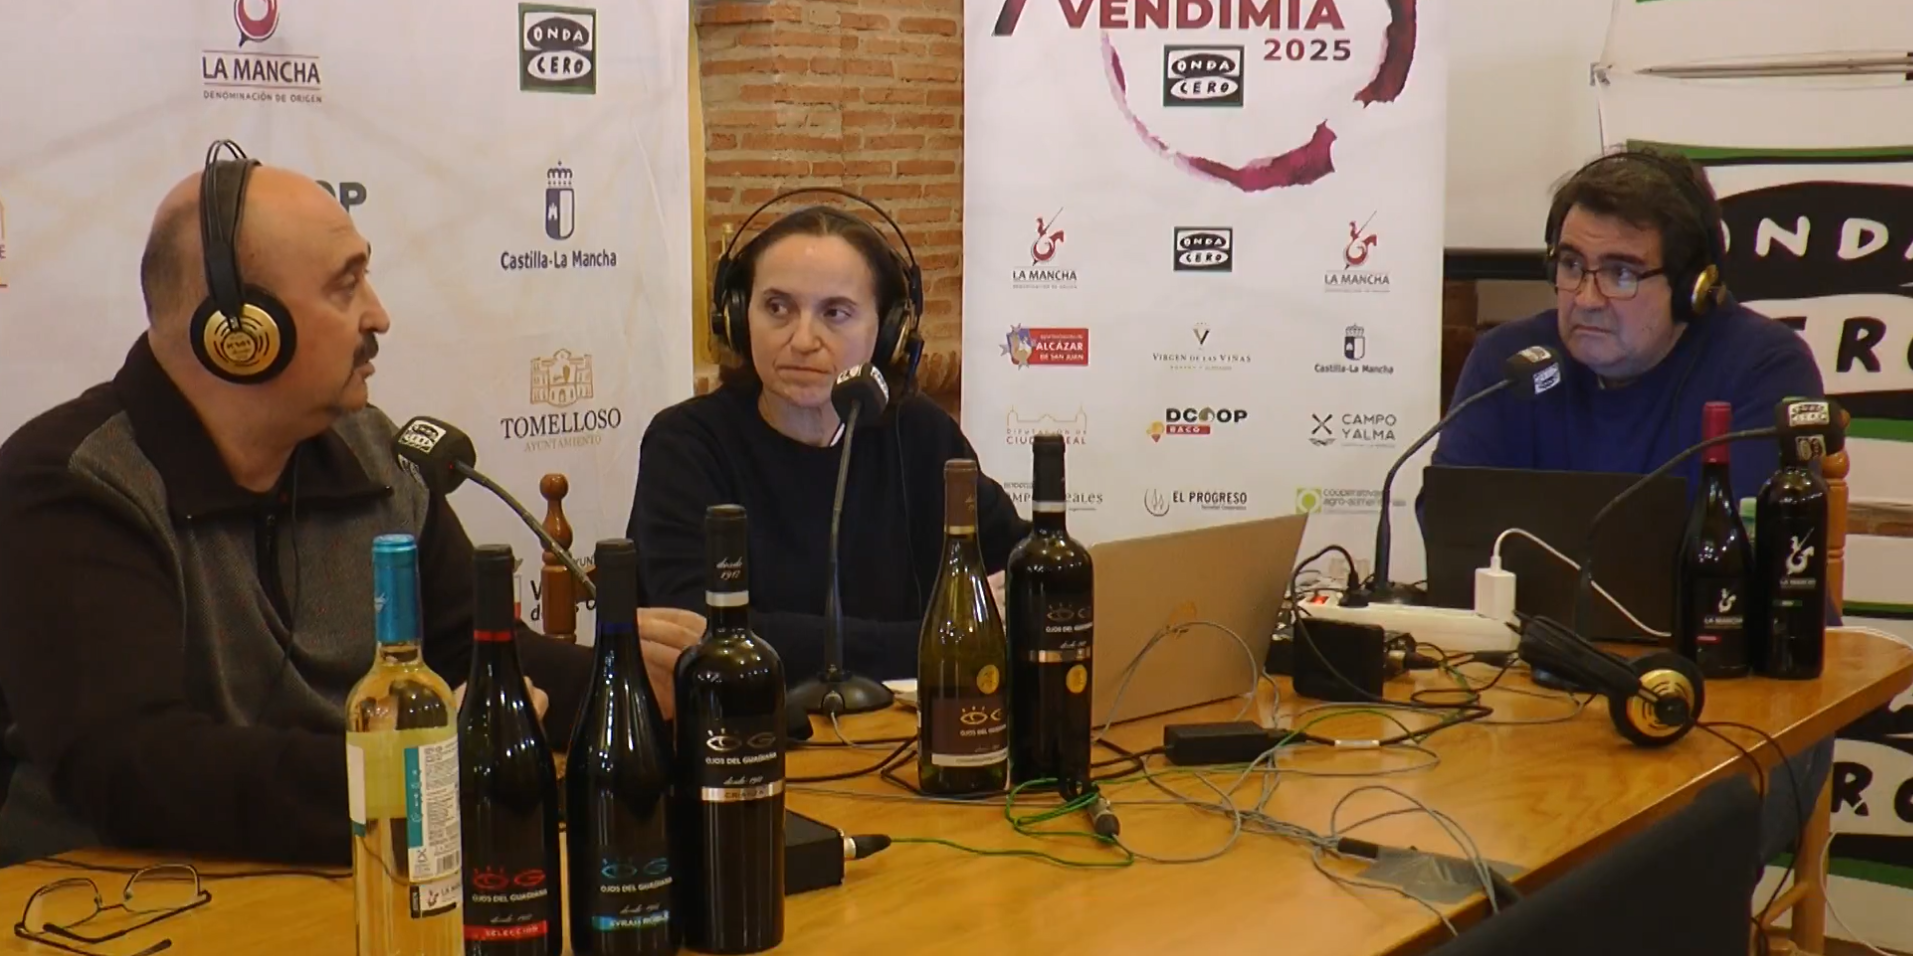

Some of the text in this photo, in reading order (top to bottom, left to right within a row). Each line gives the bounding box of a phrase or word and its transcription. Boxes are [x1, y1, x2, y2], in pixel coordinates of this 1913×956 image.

[1061, 0, 1346, 30] VENDIMIA
[533, 26, 584, 42] ONDA
[1263, 39, 1352, 61] 2025
[202, 56, 321, 84] LA MANCHA
[536, 56, 584, 75] CERO
[1176, 60, 1230, 72] ONDA
[1180, 81, 1230, 95] CERO
[203, 90, 322, 103] DENOMINACIÓN DE ORIGEN
[1183, 237, 1223, 247] ONDA
[1720, 215, 1913, 261] ND
[500, 248, 617, 270] Castilla-La Mancha
[1186, 252, 1222, 263] CERO
[1013, 270, 1077, 281] LA MANCHA
[1324, 274, 1390, 285] LA MANCHA
[1036, 340, 1084, 351] ALCÁZAR
[1314, 363, 1394, 374] Castilla-La Mancha
[500, 407, 621, 439] TOMELLOSO
[1341, 413, 1397, 426] CAMPO
[1169, 425, 1200, 433] BACO
[1341, 428, 1396, 441] YALMA
[524, 435, 602, 452] AYUNTAMIENTO
[1065, 436, 1087, 445] EAL
[1173, 490, 1247, 504] EL PROGRESO
